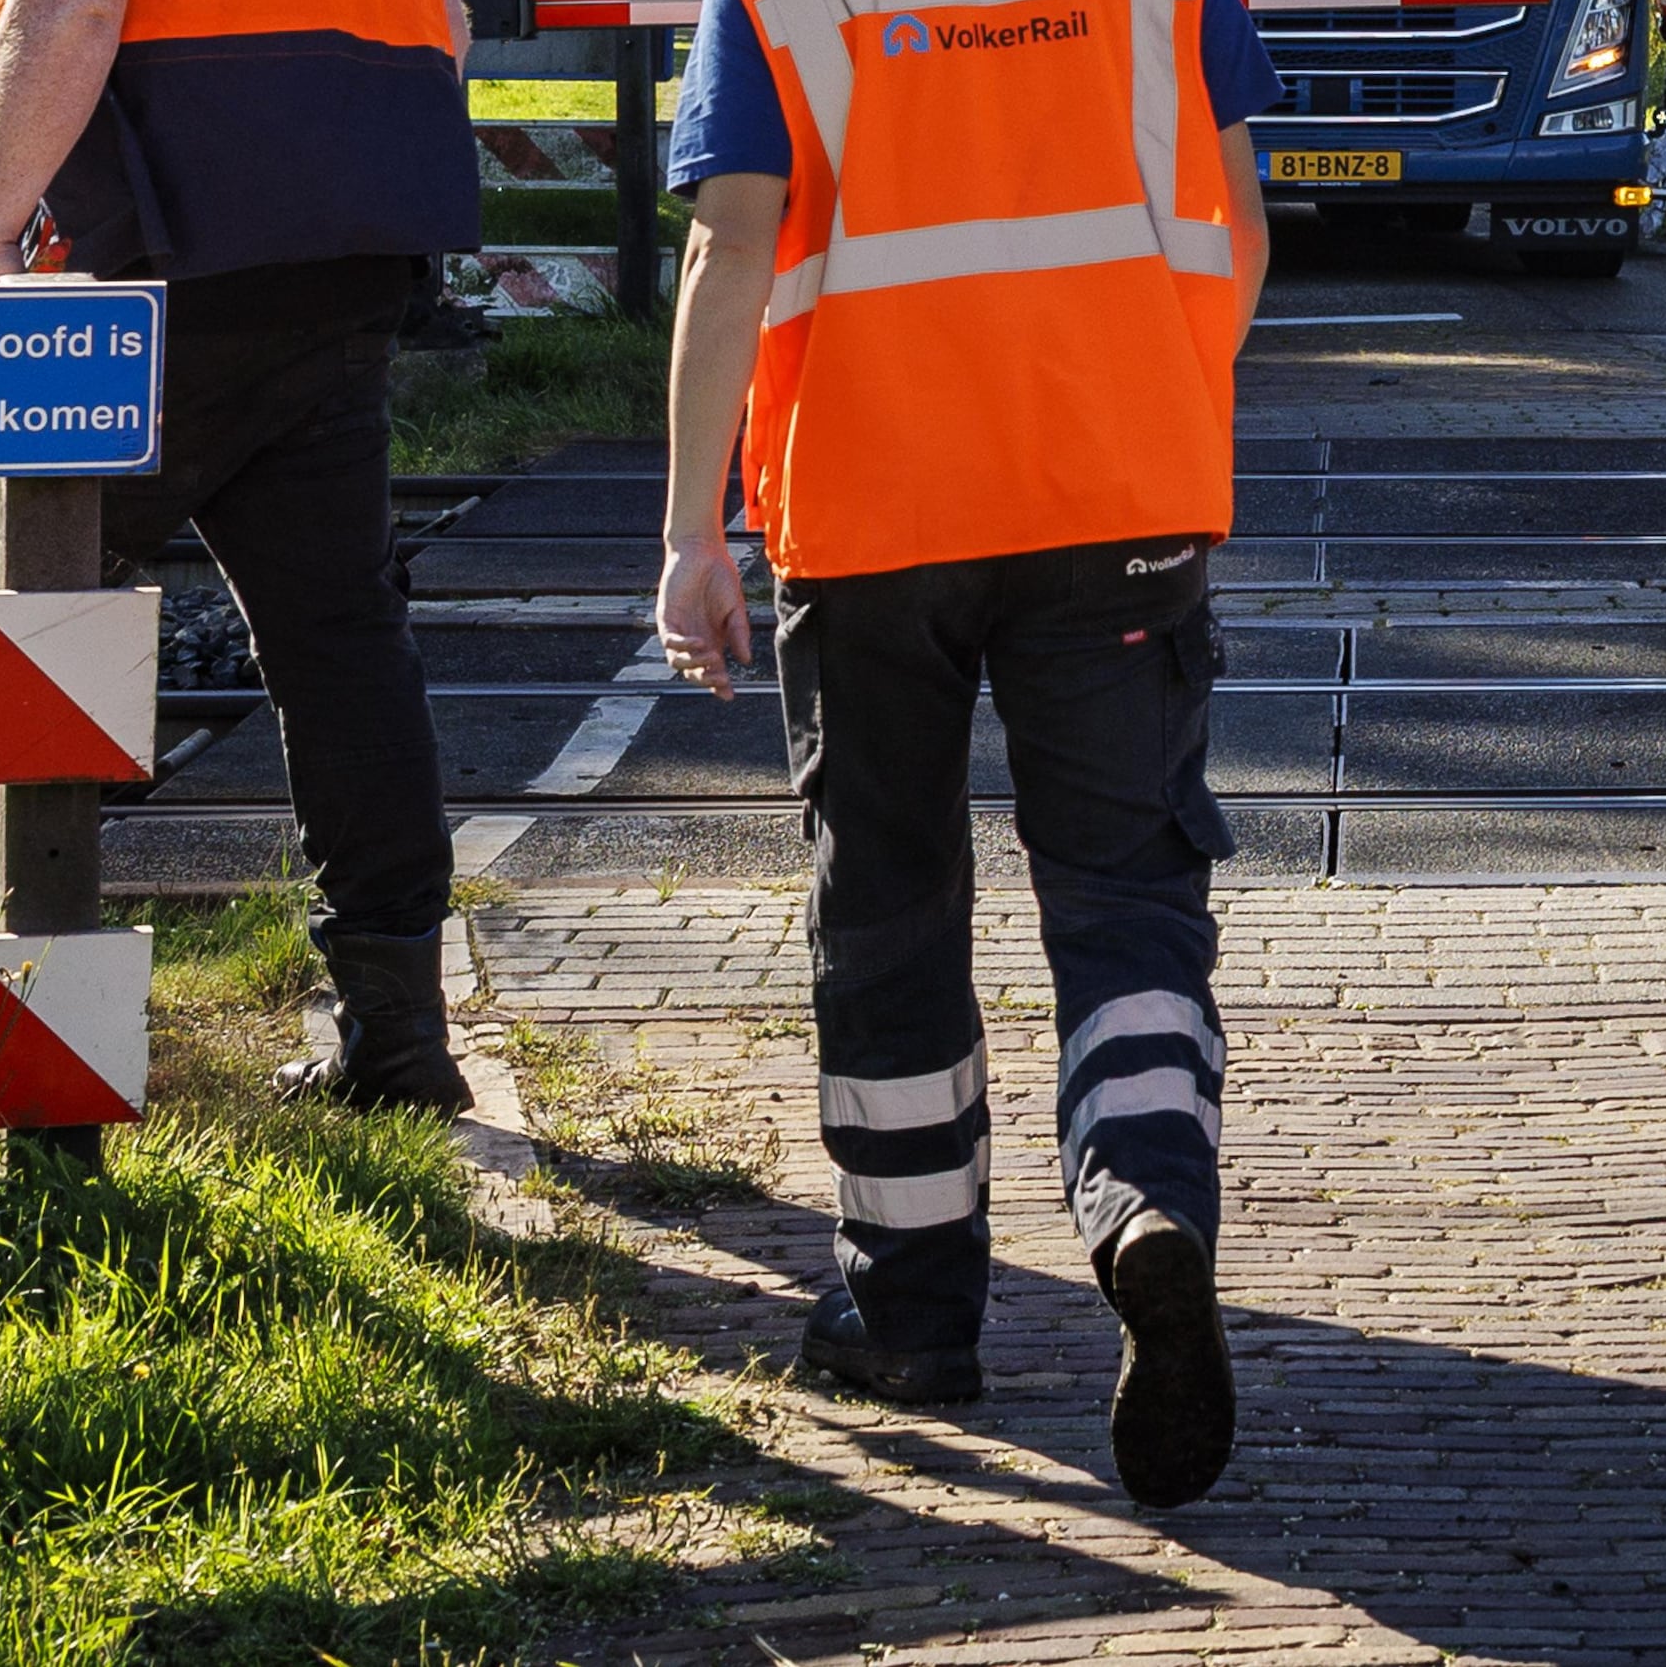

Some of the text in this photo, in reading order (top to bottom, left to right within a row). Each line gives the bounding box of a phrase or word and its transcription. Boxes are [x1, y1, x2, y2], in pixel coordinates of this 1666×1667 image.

[935, 10, 1090, 51] VolkerRail
[1280, 155, 1390, 178] 81-BNZ-8
[1501, 217, 1628, 236] VOLVO
[110, 324, 142, 357] is
[0, 400, 139, 432] komen
